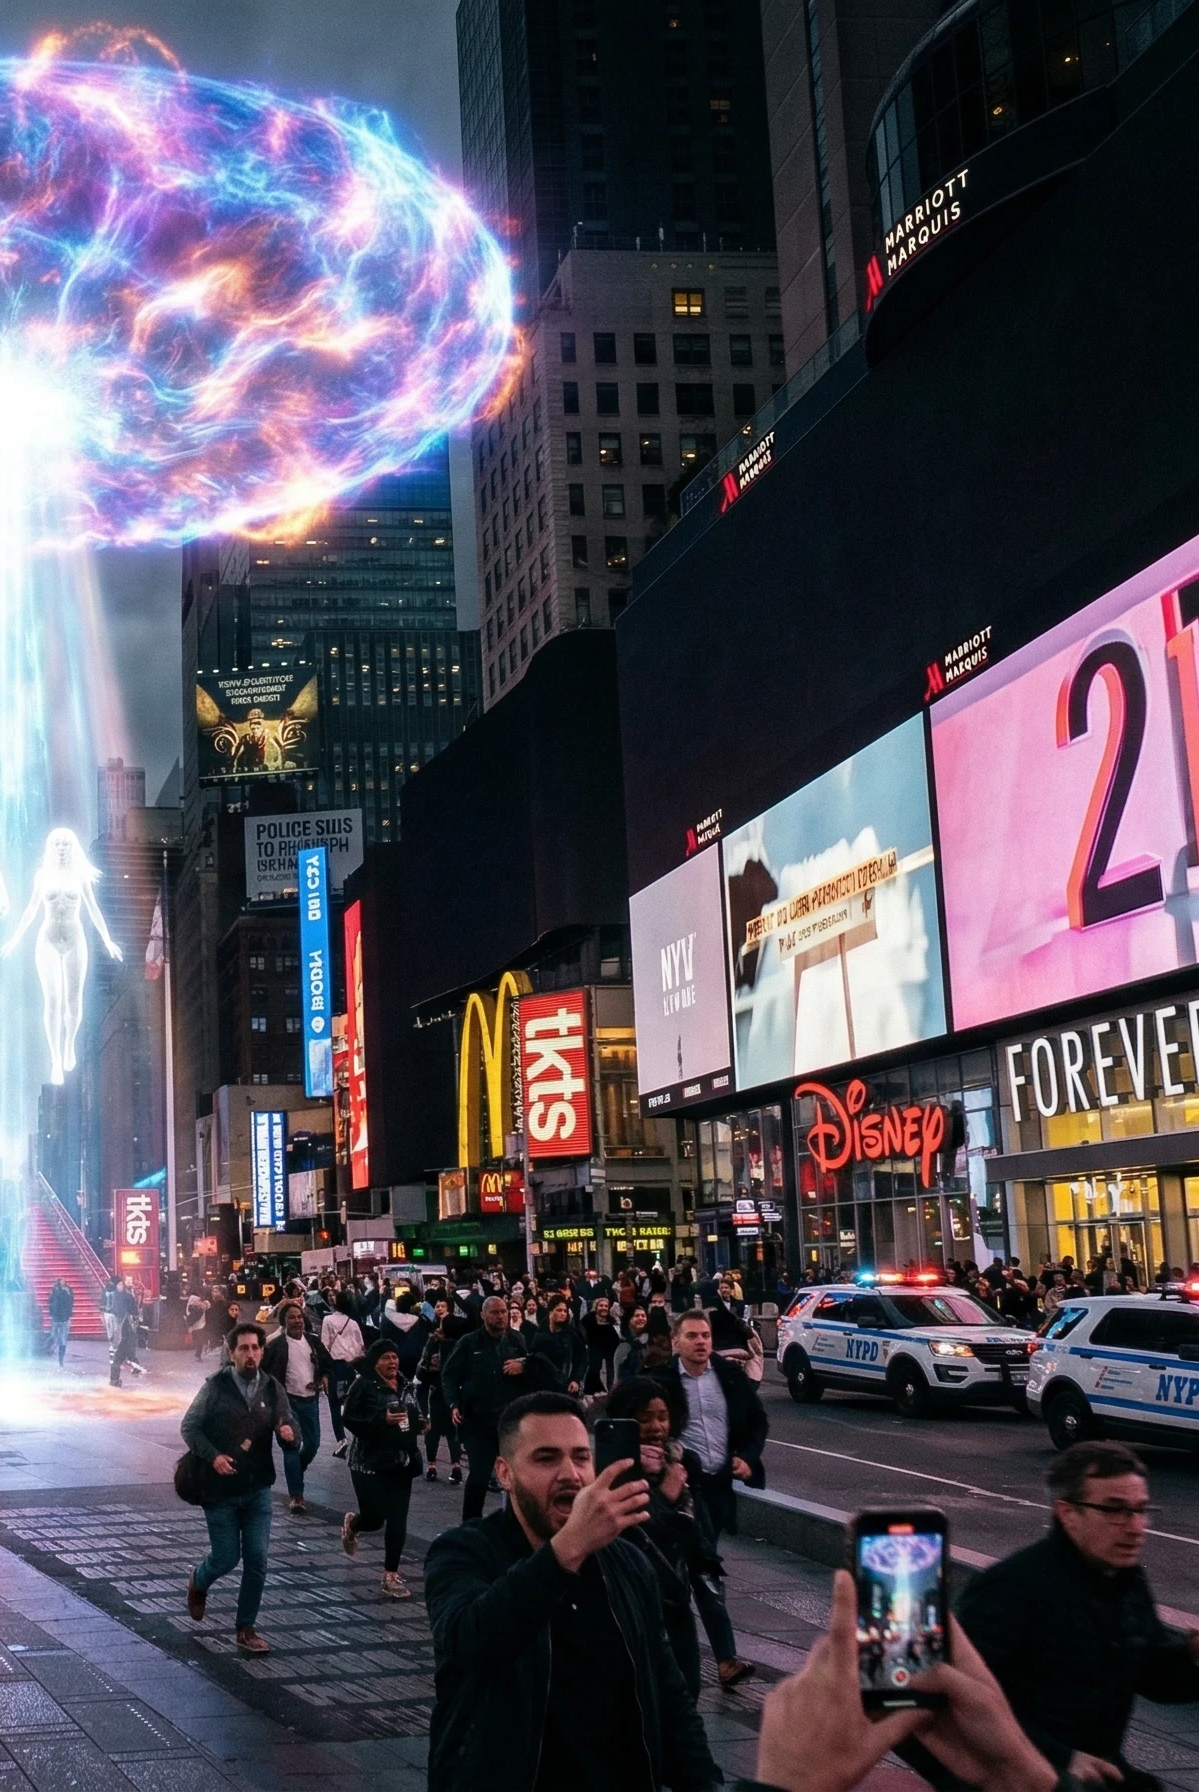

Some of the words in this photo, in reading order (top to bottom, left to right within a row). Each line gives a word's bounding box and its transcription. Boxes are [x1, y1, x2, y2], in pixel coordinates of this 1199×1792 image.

[885, 169, 968, 254] MARRIOTT
[887, 201, 961, 276] MARQUIS
[256, 820, 311, 841] POLICE
[256, 841, 274, 858] TO
[525, 1007, 586, 1142] tkts
[126, 1194, 153, 1245] tkts
[845, 1338, 879, 1362] NYPD
